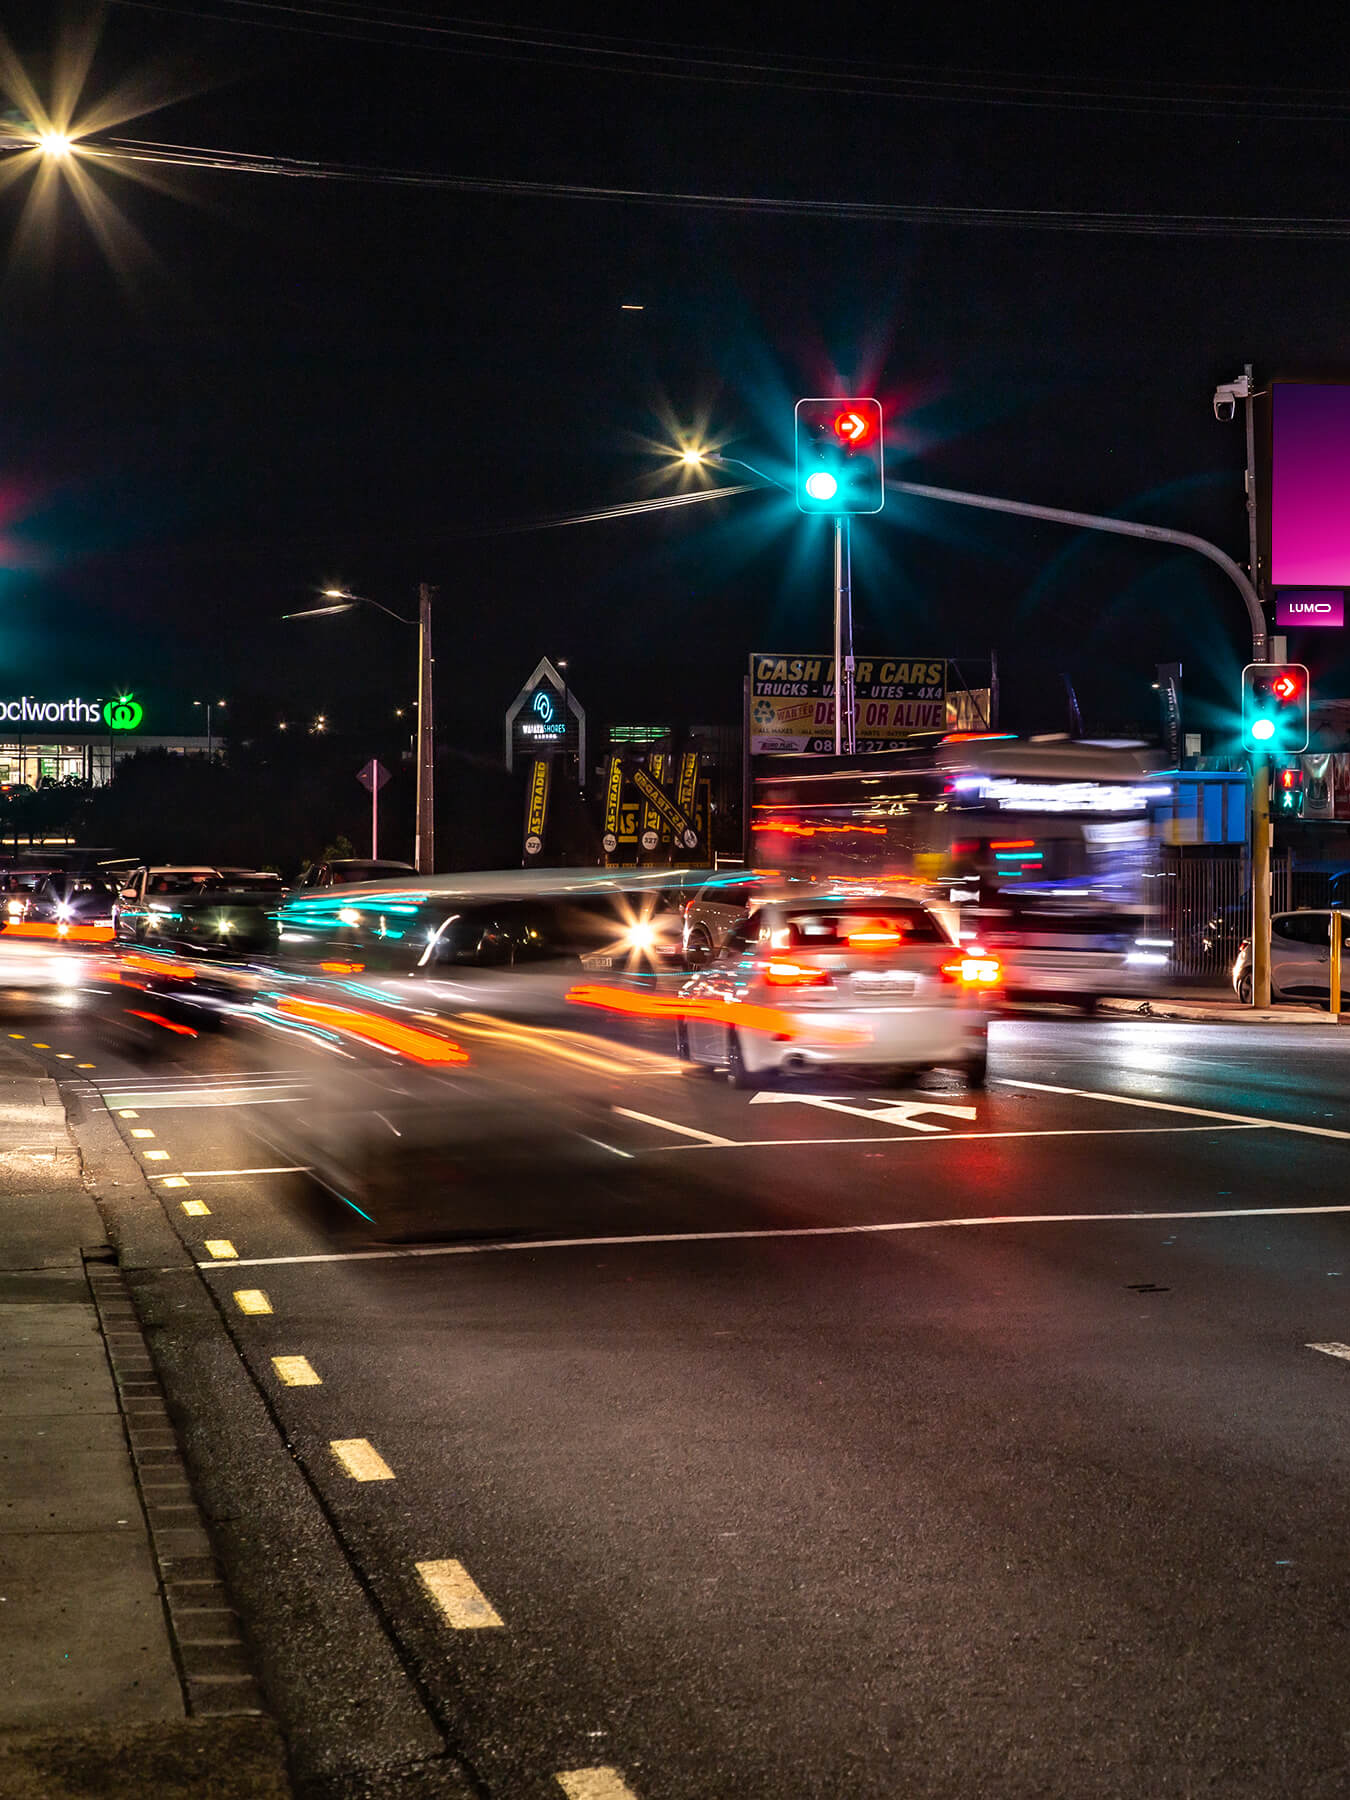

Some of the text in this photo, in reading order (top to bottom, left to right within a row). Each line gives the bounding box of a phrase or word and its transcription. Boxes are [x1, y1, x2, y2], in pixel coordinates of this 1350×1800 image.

[1289, 603, 1332, 613] LUMO
[757, 659, 822, 681] CASH
[880, 663, 943, 685] CARS
[756, 682, 808, 696] TRUCKS
[871, 686, 904, 698] UTES
[917, 687, 943, 699] 4X4
[866, 703, 889, 726] OR
[893, 704, 942, 727] ALIVE
[530, 762, 546, 835] AS-TRADED
